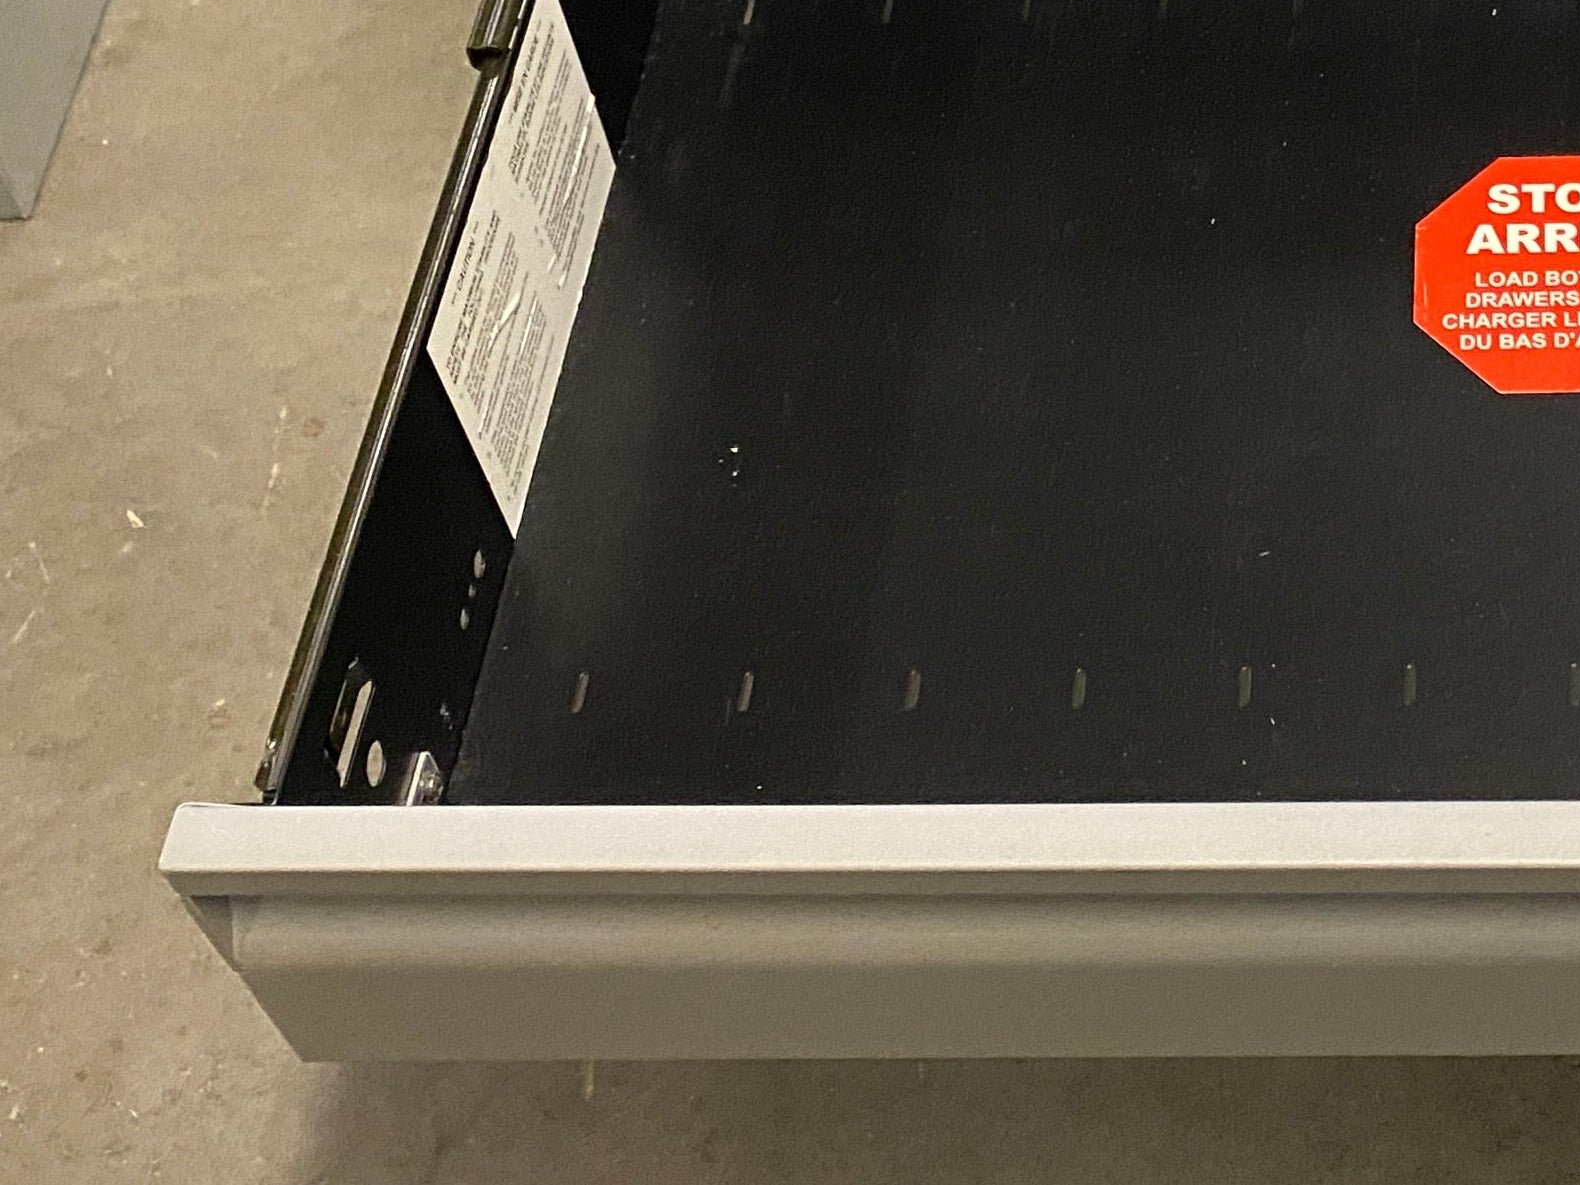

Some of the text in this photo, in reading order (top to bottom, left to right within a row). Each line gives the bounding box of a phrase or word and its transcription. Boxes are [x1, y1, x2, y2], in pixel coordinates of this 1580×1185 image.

[1475, 271, 1539, 288] LOAD
[1465, 291, 1580, 308] DRAWERS
[1442, 312, 1558, 330] CHARGER
[1459, 334, 1492, 350] DU
[1499, 333, 1547, 349] BAS
